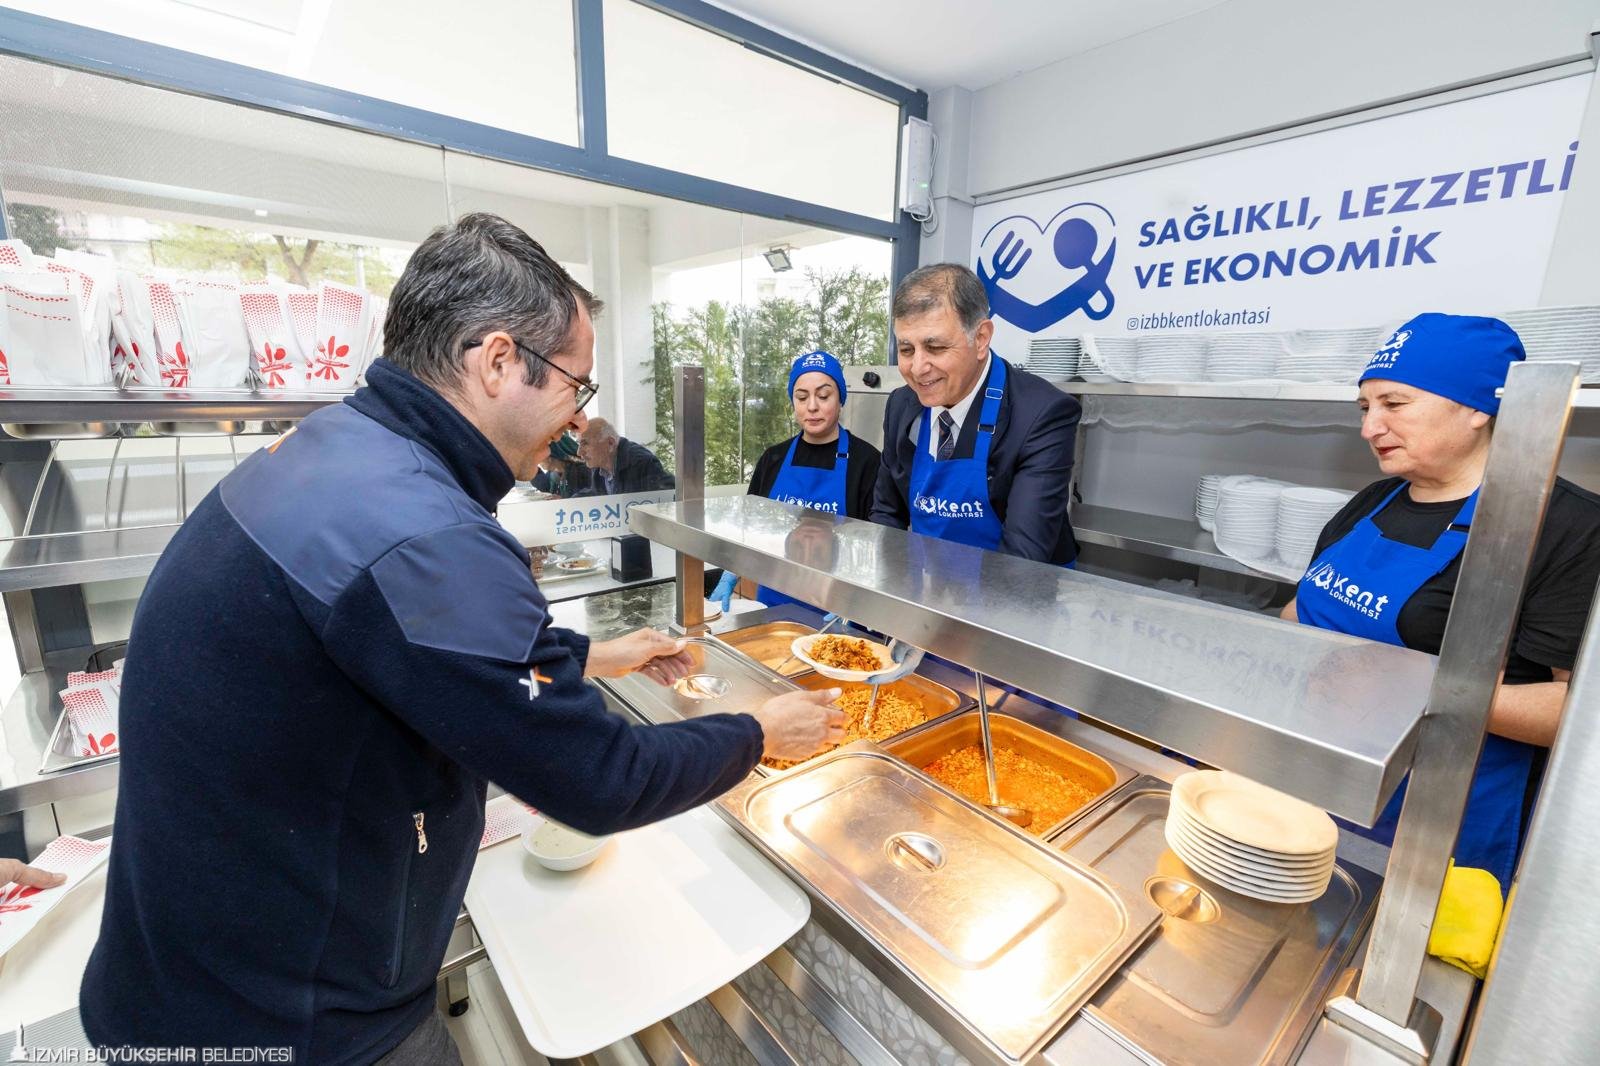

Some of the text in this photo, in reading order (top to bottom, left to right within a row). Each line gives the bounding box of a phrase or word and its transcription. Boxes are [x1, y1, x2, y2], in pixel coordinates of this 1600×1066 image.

[1138, 140, 1580, 248] SAĞLIKLI, LEZZETLİ
[1134, 226, 1442, 289] VE EKONOMİK
[938, 498, 983, 512] Kent
[1329, 588, 1380, 620] LOKANTASI
[1333, 573, 1389, 612] Kent
